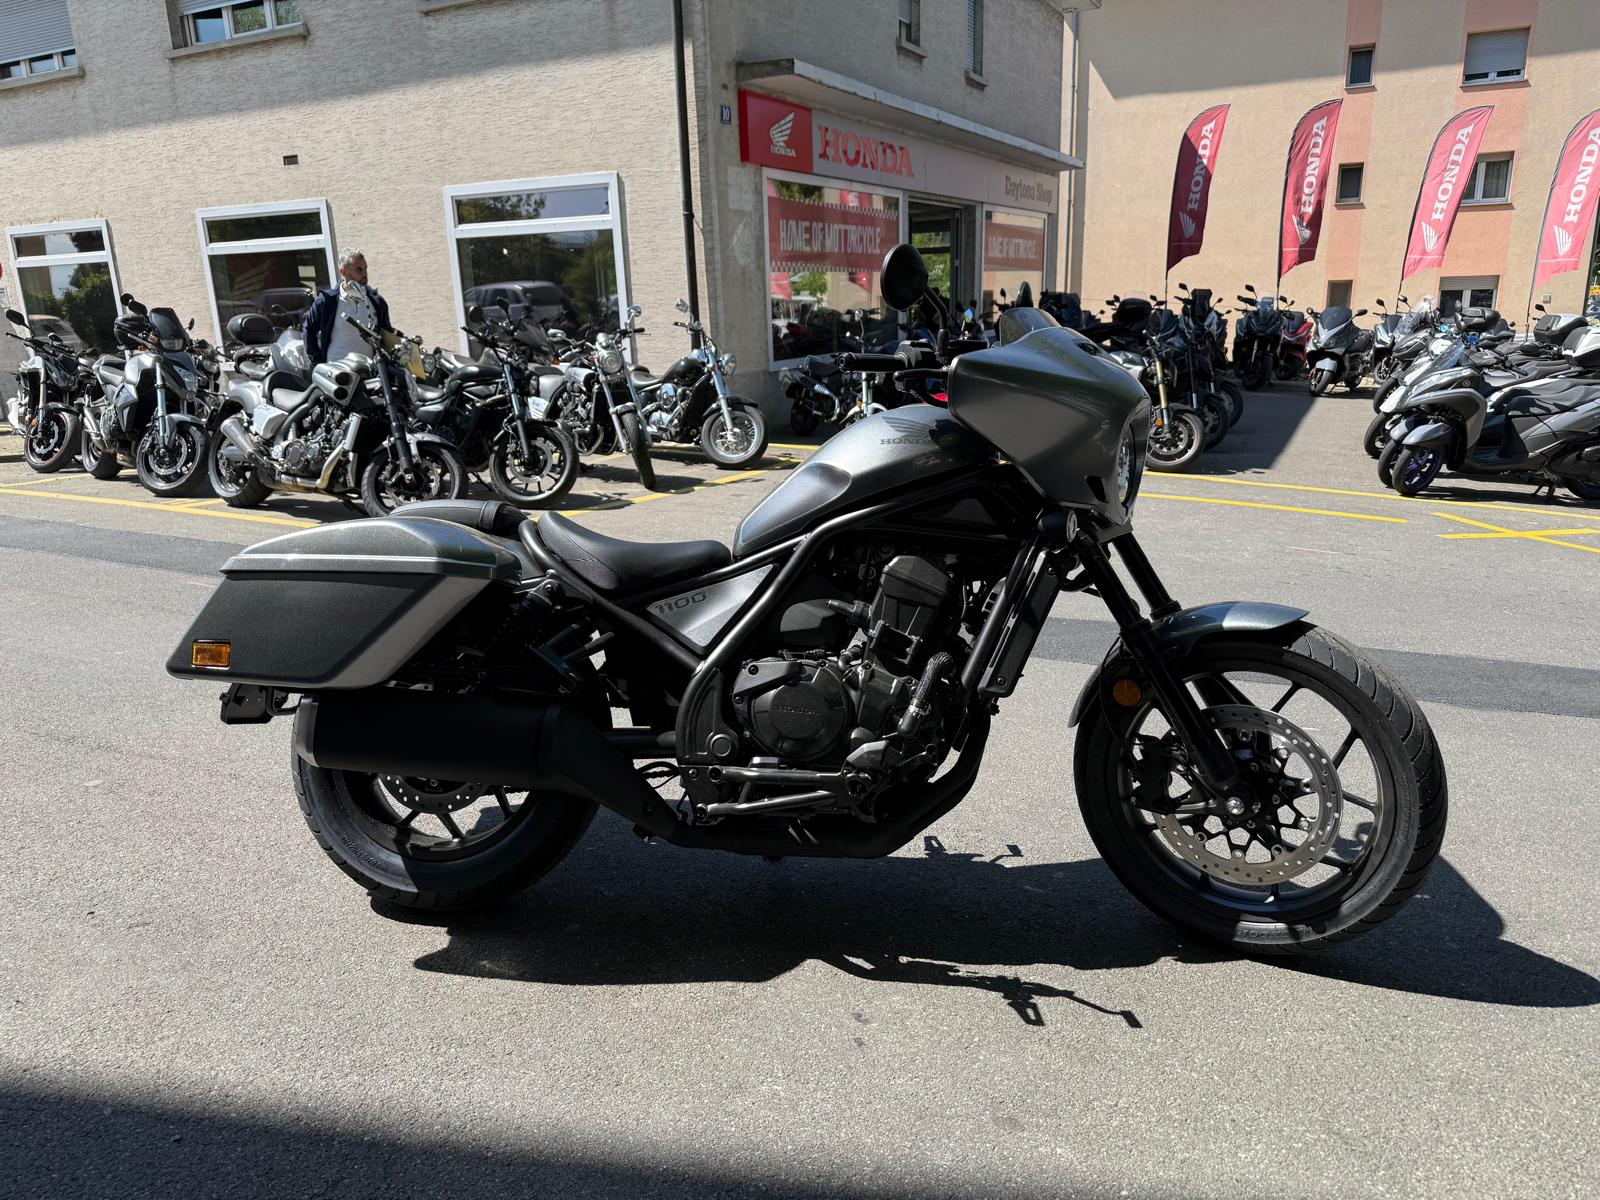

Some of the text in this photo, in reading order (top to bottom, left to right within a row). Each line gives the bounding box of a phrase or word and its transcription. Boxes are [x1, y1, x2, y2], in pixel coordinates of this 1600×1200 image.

[770, 145, 797, 157] HONDA
[817, 125, 914, 178] HONDA
[1187, 119, 1216, 211] HONDA
[1301, 116, 1328, 214] HONDA
[1431, 122, 1475, 222] HONDA
[1563, 126, 1600, 224] HONDA
[1005, 174, 1052, 207] Daytona Shop
[780, 218, 811, 252] HOME
[812, 221, 824, 253] OF
[655, 590, 707, 614] 1100
